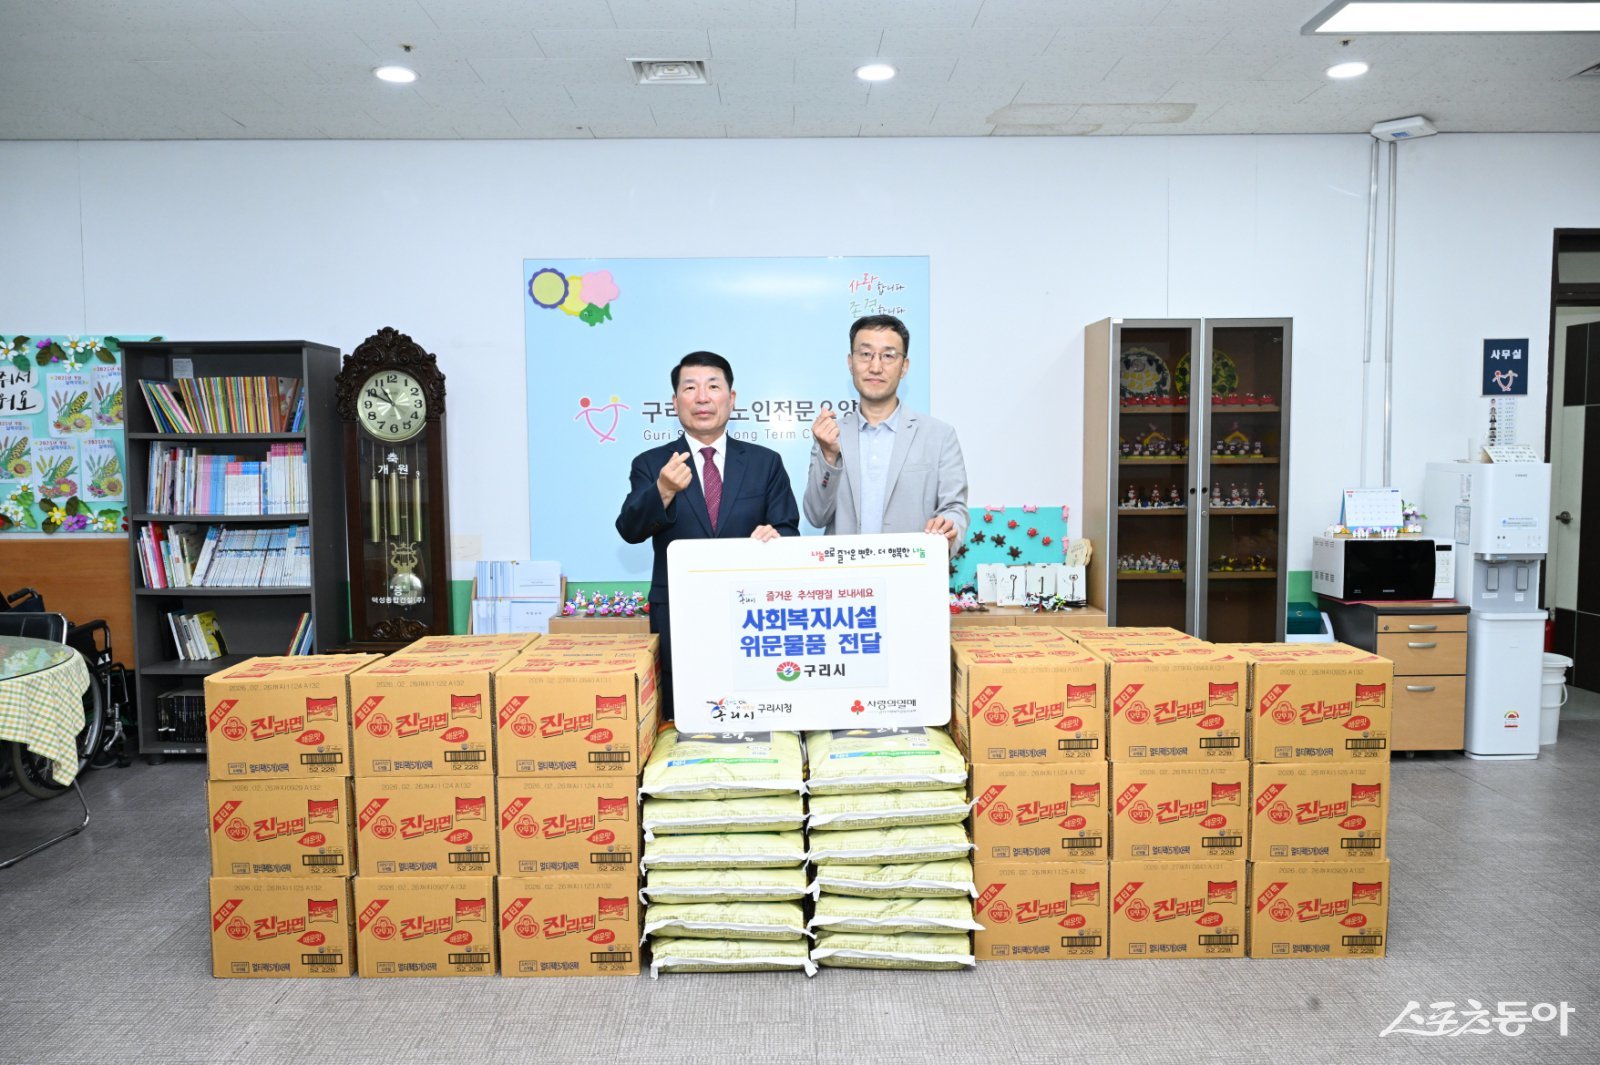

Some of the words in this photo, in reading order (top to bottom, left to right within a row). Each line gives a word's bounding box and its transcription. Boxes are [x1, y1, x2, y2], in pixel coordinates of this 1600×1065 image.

[849, 272, 905, 295] 사랑합니다
[1490, 349, 1522, 360] 사무실
[386, 375, 398, 383] 12
[367, 389, 376, 397] 10
[411, 388, 419, 396] 2
[364, 401, 372, 409] 9
[414, 400, 423, 408] 3
[368, 412, 376, 420] 8
[411, 411, 419, 419] 4
[377, 421, 385, 429] 7
[390, 424, 398, 433] 6
[403, 420, 411, 429] 5
[643, 429, 671, 440] Guri
[764, 428, 796, 440] Term
[811, 547, 835, 562] 나눔으로
[837, 549, 856, 564] 즐거운
[888, 547, 910, 558] 행복한
[912, 547, 926, 558] 나눔
[766, 590, 793, 602] 즐거운
[797, 589, 833, 601] 추석명절
[837, 588, 874, 598] 보내세요
[742, 605, 877, 632] 사회복지시설
[740, 634, 827, 657] 위문물품
[838, 632, 882, 655] 전달
[803, 663, 846, 677] 구리시
[758, 703, 792, 713] 구리시청
[867, 699, 917, 710] 사랑의열매
[1012, 701, 1065, 727] 진라면
[1153, 700, 1206, 725] 진라면
[1300, 700, 1353, 726] 진라면
[250, 715, 304, 741] 진라면
[395, 712, 449, 738] 진라면
[539, 713, 593, 739] 진라면
[1060, 719, 1080, 729] 매운맛
[1201, 717, 1222, 728] 매운맛
[1347, 718, 1368, 729] 매운맛
[301, 733, 321, 744] 매운맛
[445, 730, 465, 741] 매운맛
[589, 731, 610, 742] 매운맛
[1016, 801, 1068, 825] 진라면
[1157, 799, 1208, 824] 진라면
[1295, 800, 1348, 825] 진라면
[400, 814, 453, 840] 진라면
[542, 814, 596, 840] 진라면
[1064, 818, 1083, 828] 매운맛
[1204, 817, 1224, 827] 매운맛
[1344, 818, 1363, 828] 매운맛
[253, 817, 306, 842] 진라면
[302, 835, 323, 845] 매운맛
[449, 832, 470, 843] 매운맛
[591, 832, 612, 843] 매운맛
[1016, 899, 1067, 924] 진라면
[1153, 897, 1205, 922] 진라면
[1297, 898, 1349, 923] 진라면
[1063, 917, 1083, 927] 매운맛
[1201, 915, 1220, 925] 매운맛
[1344, 916, 1364, 926] 매운맛
[253, 916, 306, 941] 진라면
[400, 915, 453, 941] 진라면
[543, 914, 596, 940] 진라면
[302, 934, 322, 944] 매운맛
[449, 933, 469, 944] 매운맛
[592, 932, 612, 943] 매운맛
